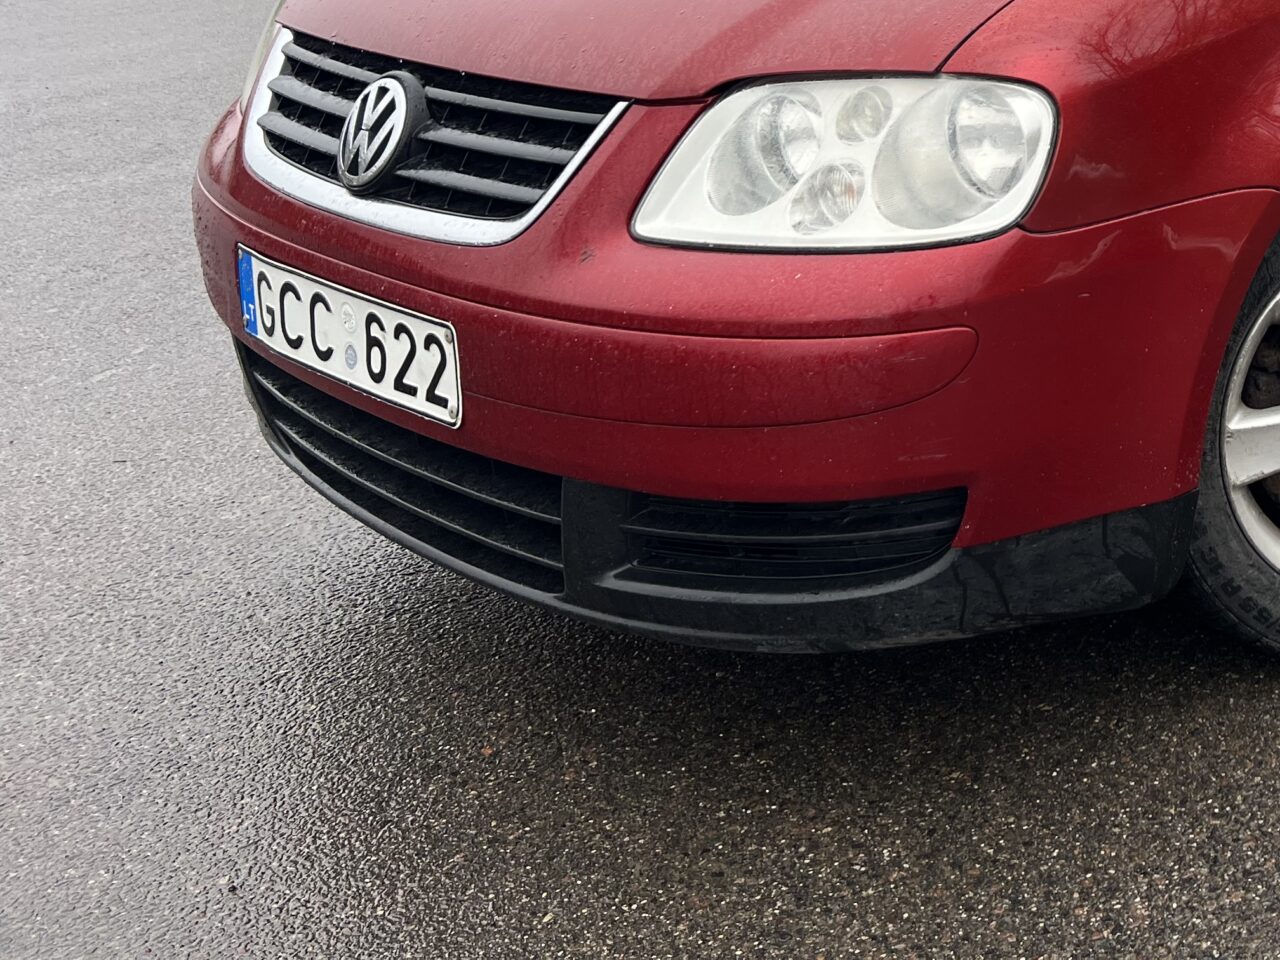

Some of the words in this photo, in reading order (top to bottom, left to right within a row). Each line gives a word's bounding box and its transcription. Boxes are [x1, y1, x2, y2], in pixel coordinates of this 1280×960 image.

[338, 77, 407, 187] VW
[257, 270, 334, 362] GCC
[365, 311, 449, 409] 622
